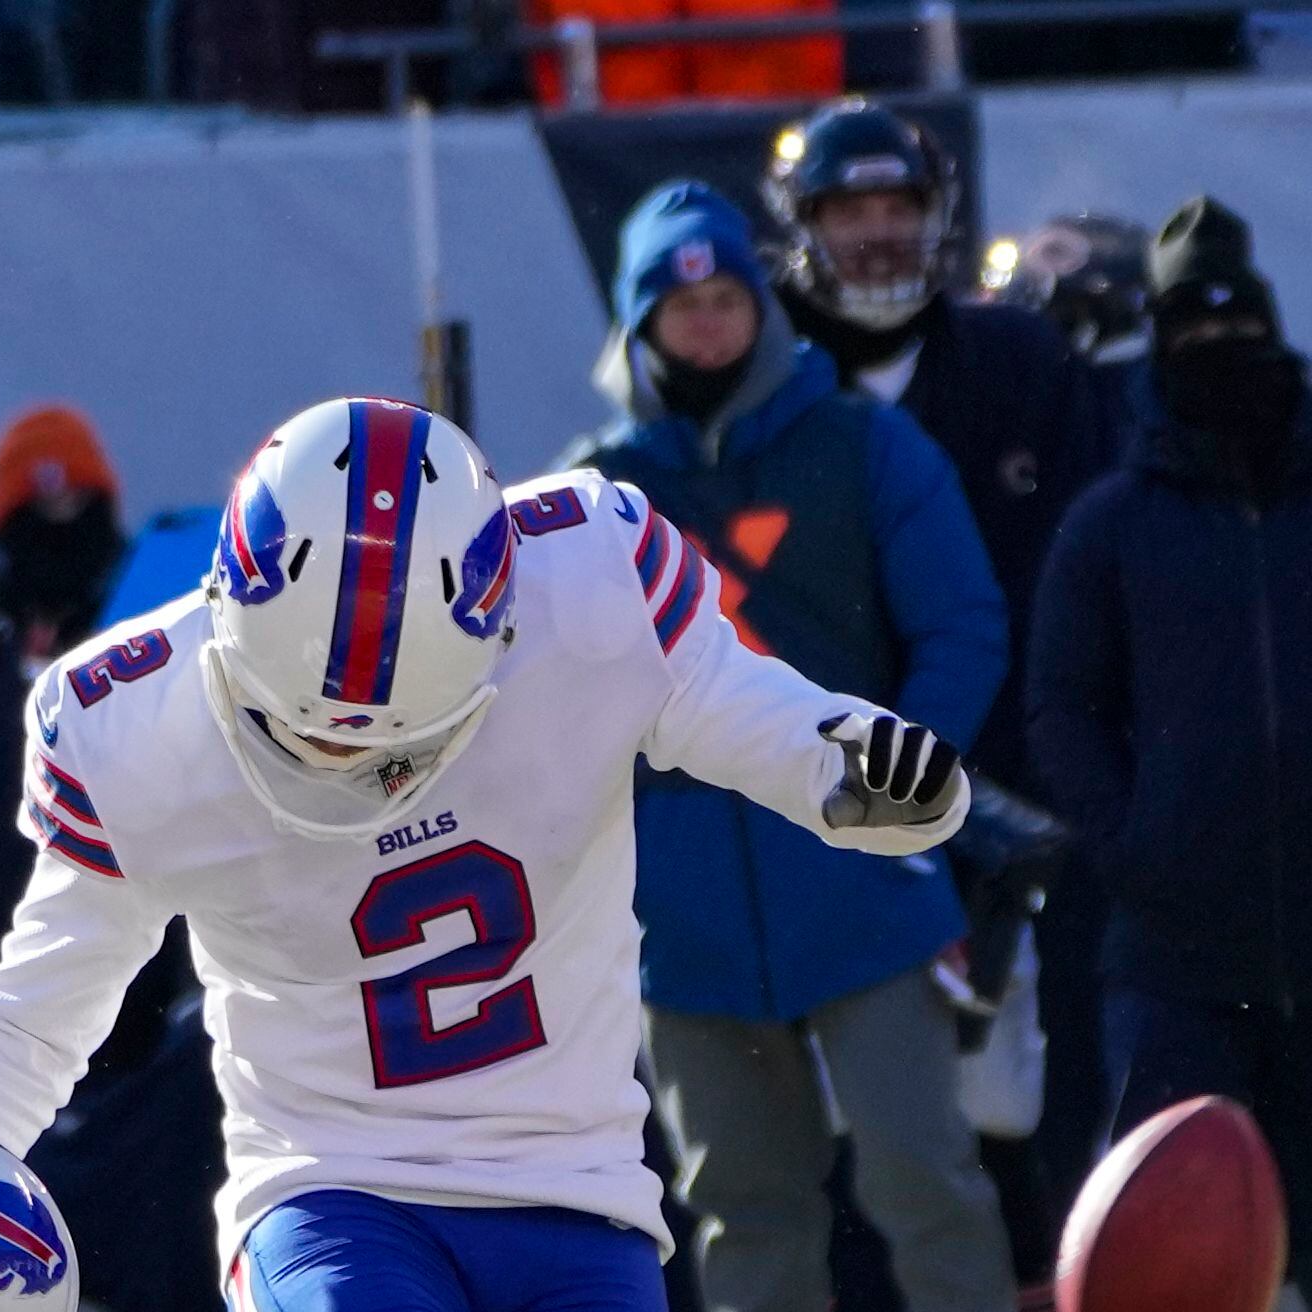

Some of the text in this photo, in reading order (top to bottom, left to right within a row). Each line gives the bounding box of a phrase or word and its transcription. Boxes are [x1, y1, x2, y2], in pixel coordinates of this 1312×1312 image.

[508, 486, 588, 545] 2
[66, 628, 173, 710] 2
[375, 811, 458, 856] BILLS
[350, 839, 548, 1090] 2
